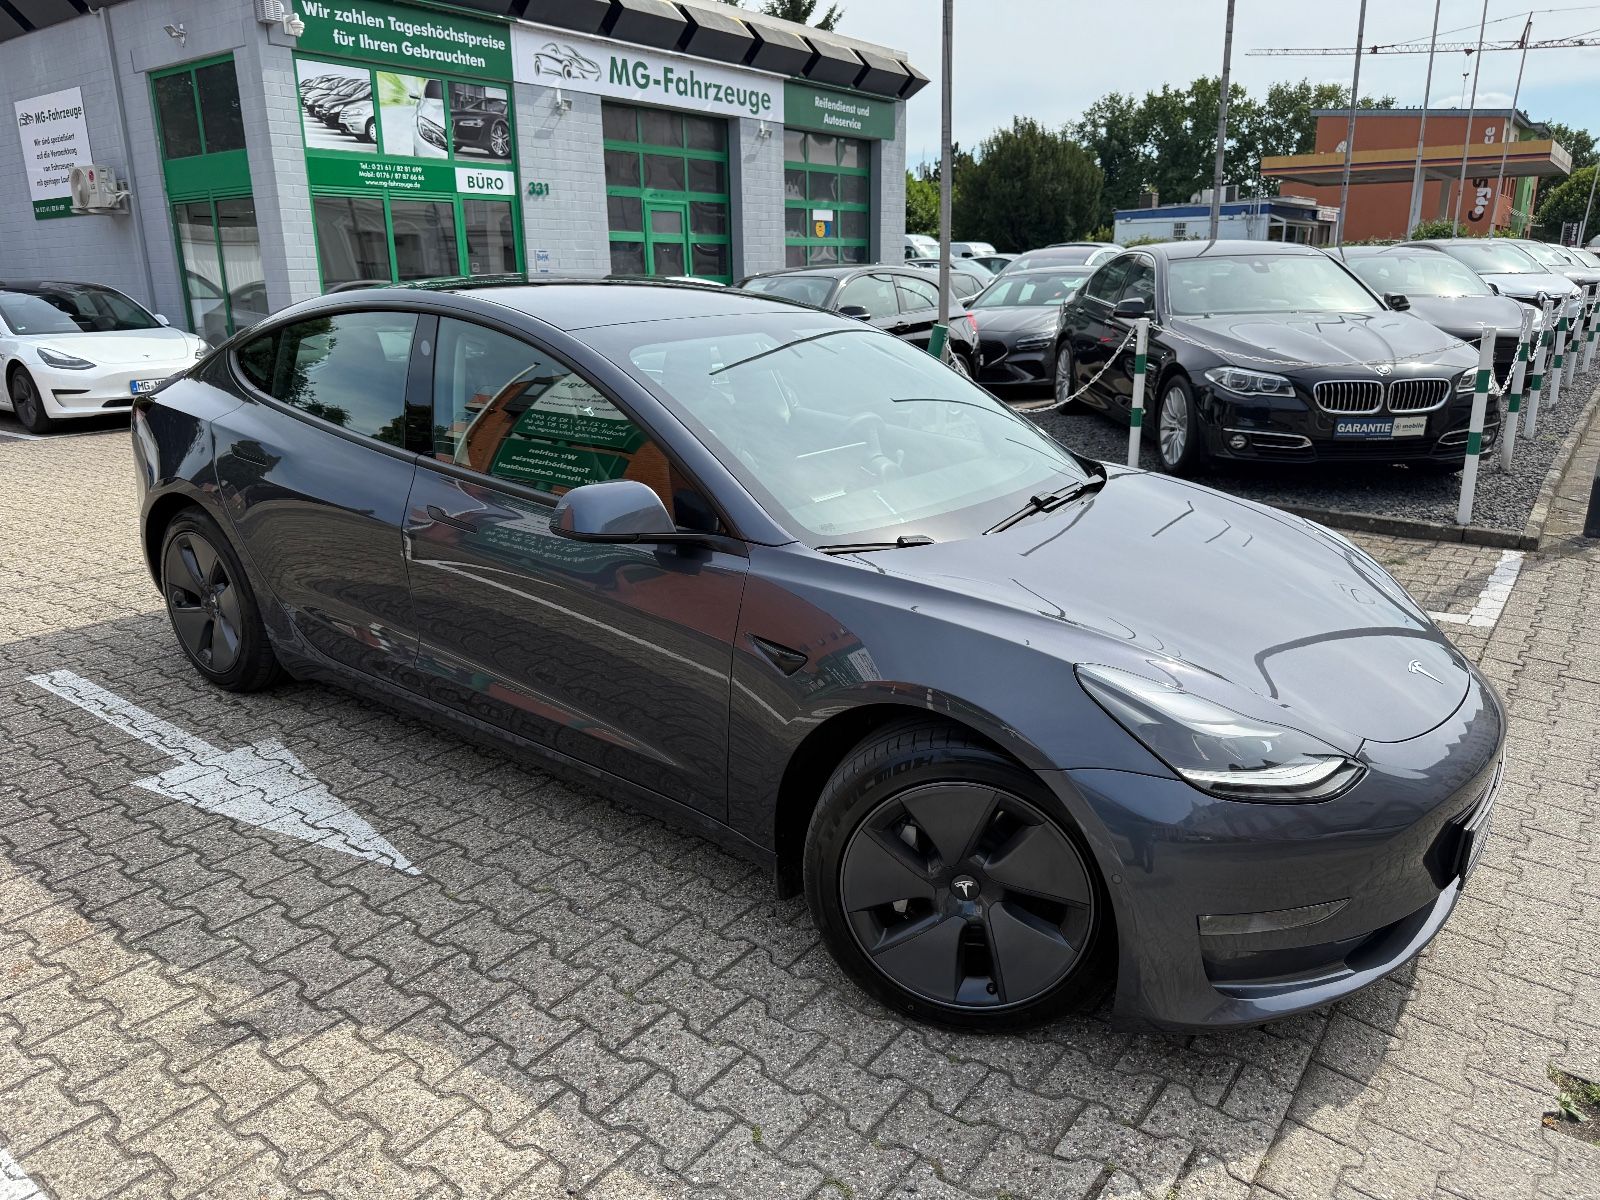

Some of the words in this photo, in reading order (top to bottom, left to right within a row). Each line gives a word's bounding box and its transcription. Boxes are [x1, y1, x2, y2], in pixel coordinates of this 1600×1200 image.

[302, 0, 330, 18] Wir
[334, 8, 384, 29] zahlen
[388, 16, 506, 50] Tageshöchstpreise
[333, 29, 355, 46] für
[360, 34, 398, 54] Ihren
[402, 41, 486, 68] Gebrauchten
[609, 56, 771, 115] MG-Fahrzeuge
[34, 106, 82, 124] MG-Fahrzeuge
[815, 96, 856, 115] Reifendienst
[857, 105, 870, 117] und
[823, 113, 862, 130] Autoservice
[467, 173, 504, 190] BÜRO
[528, 182, 549, 196] 331
[1337, 423, 1392, 432] GARANTIE
